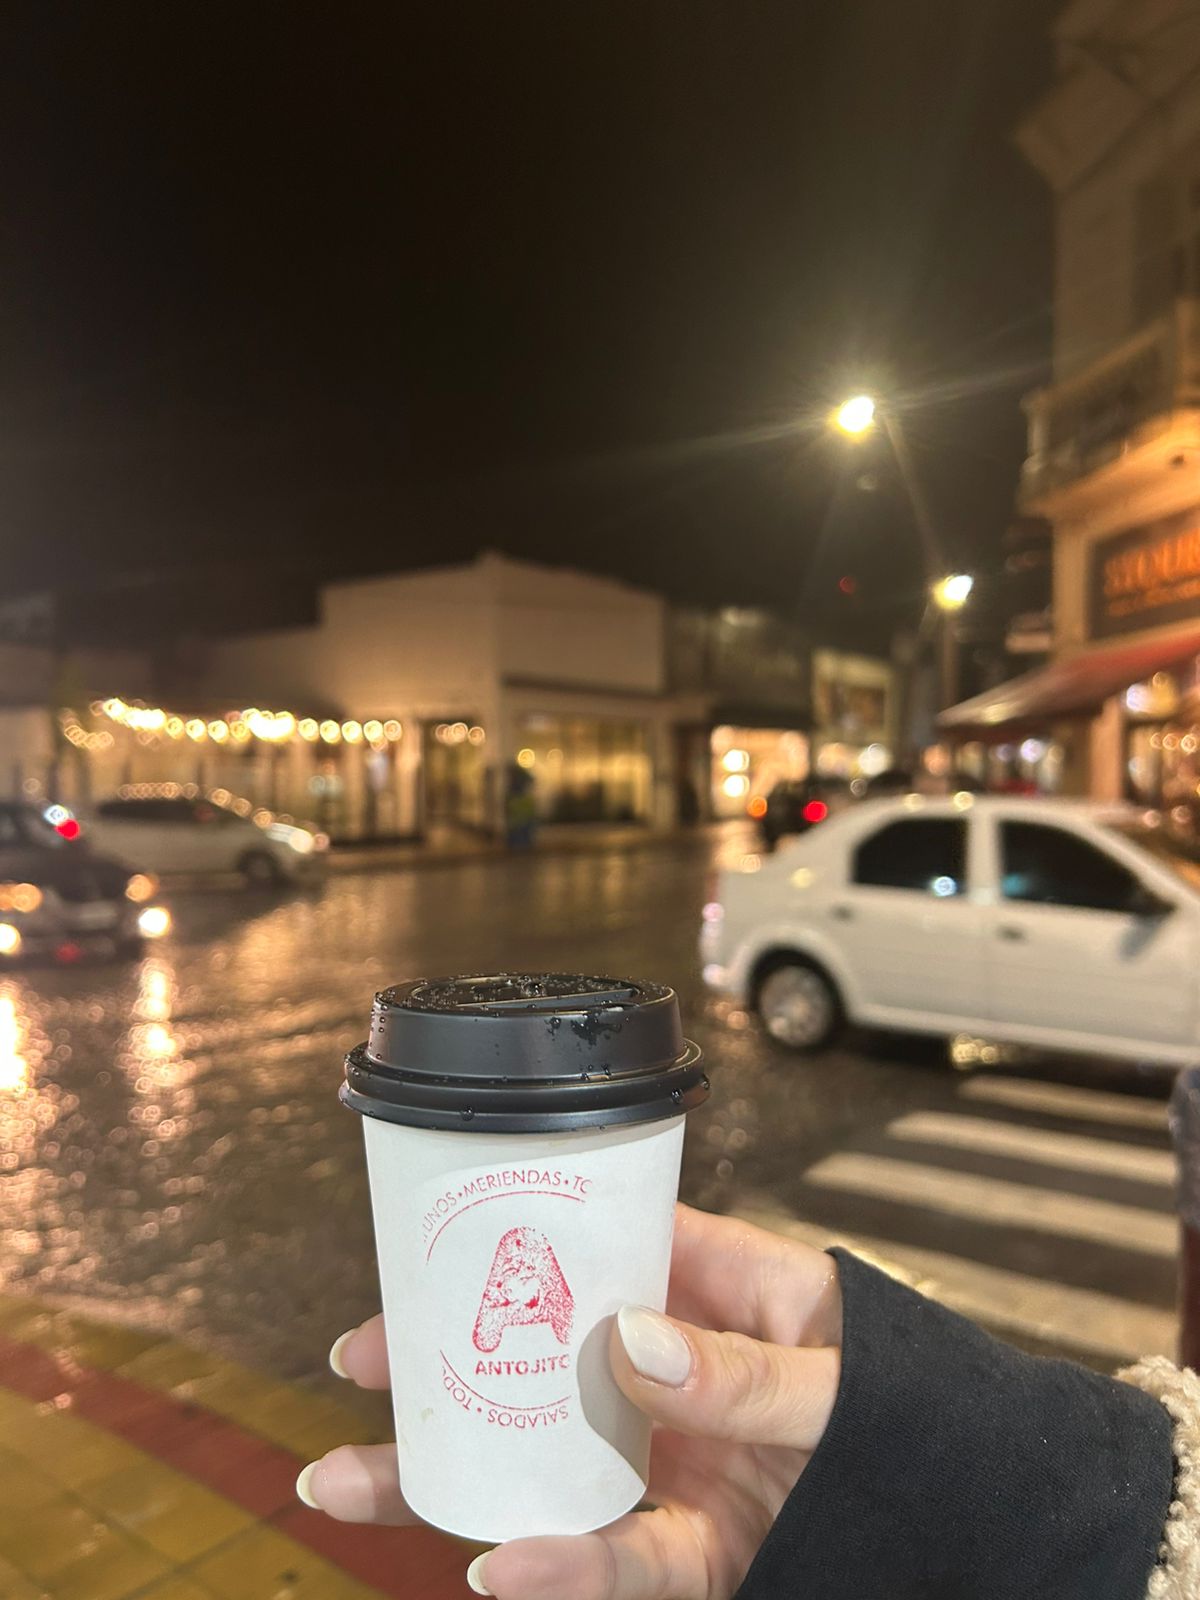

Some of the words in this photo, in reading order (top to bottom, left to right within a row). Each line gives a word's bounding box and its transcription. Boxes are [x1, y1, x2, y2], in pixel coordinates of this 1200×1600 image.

[422, 1191, 457, 1242] UNOS
[463, 1169, 561, 1198] MERIENDAS
[487, 1405, 568, 1429] SALADOS
